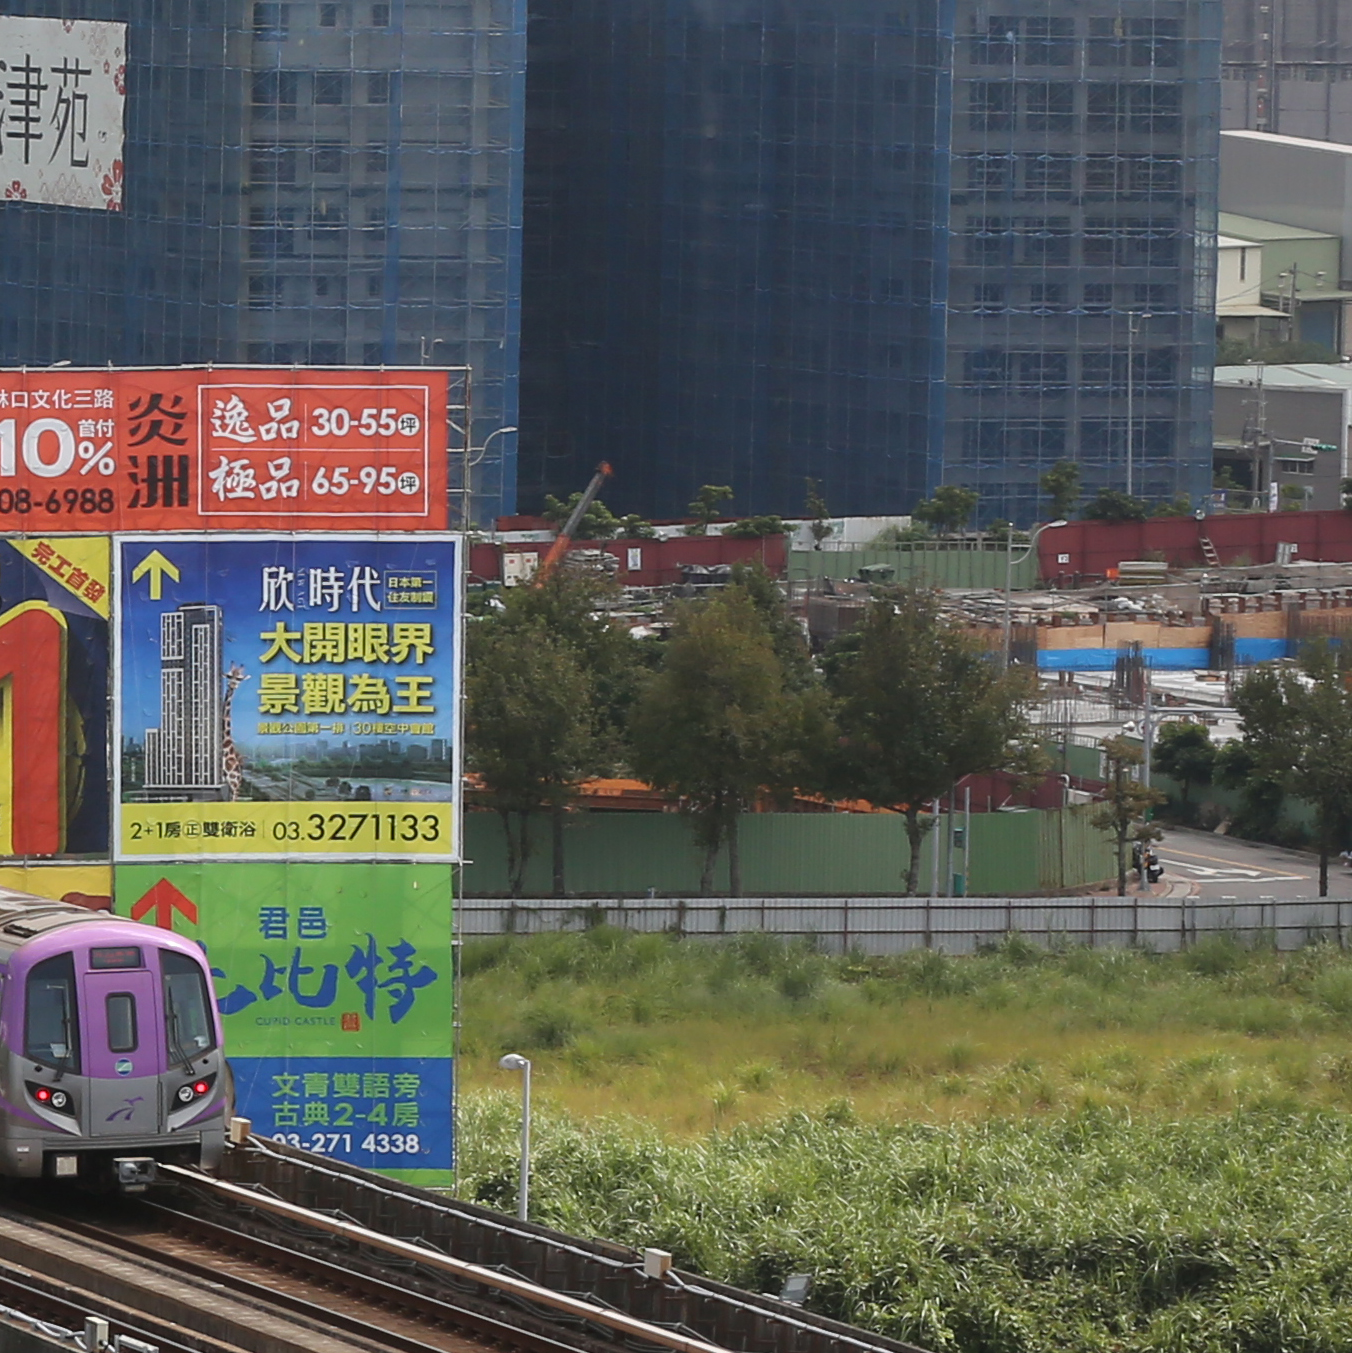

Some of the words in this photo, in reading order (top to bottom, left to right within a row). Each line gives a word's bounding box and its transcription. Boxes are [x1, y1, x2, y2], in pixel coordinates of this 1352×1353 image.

[77, 419, 115, 438] 首付
[211, 394, 300, 443] 逸品
[127, 393, 190, 509] 炎洲
[209, 456, 300, 502] 極品
[30, 541, 107, 604] 完工首發
[259, 566, 381, 612] 欣時代
[388, 576, 434, 588] 日本第一
[258, 621, 435, 664] 大開眼界
[257, 672, 435, 714] 景觀為王
[272, 813, 440, 843] 03.3271133
[258, 906, 327, 940] 君邑
[255, 1016, 291, 1026] CUPID
[294, 1017, 336, 1026] CASTLE
[271, 1073, 421, 1098] 文青雙語旁
[272, 1102, 421, 1128] 古典2-4房
[361, 1134, 421, 1155] 4338
